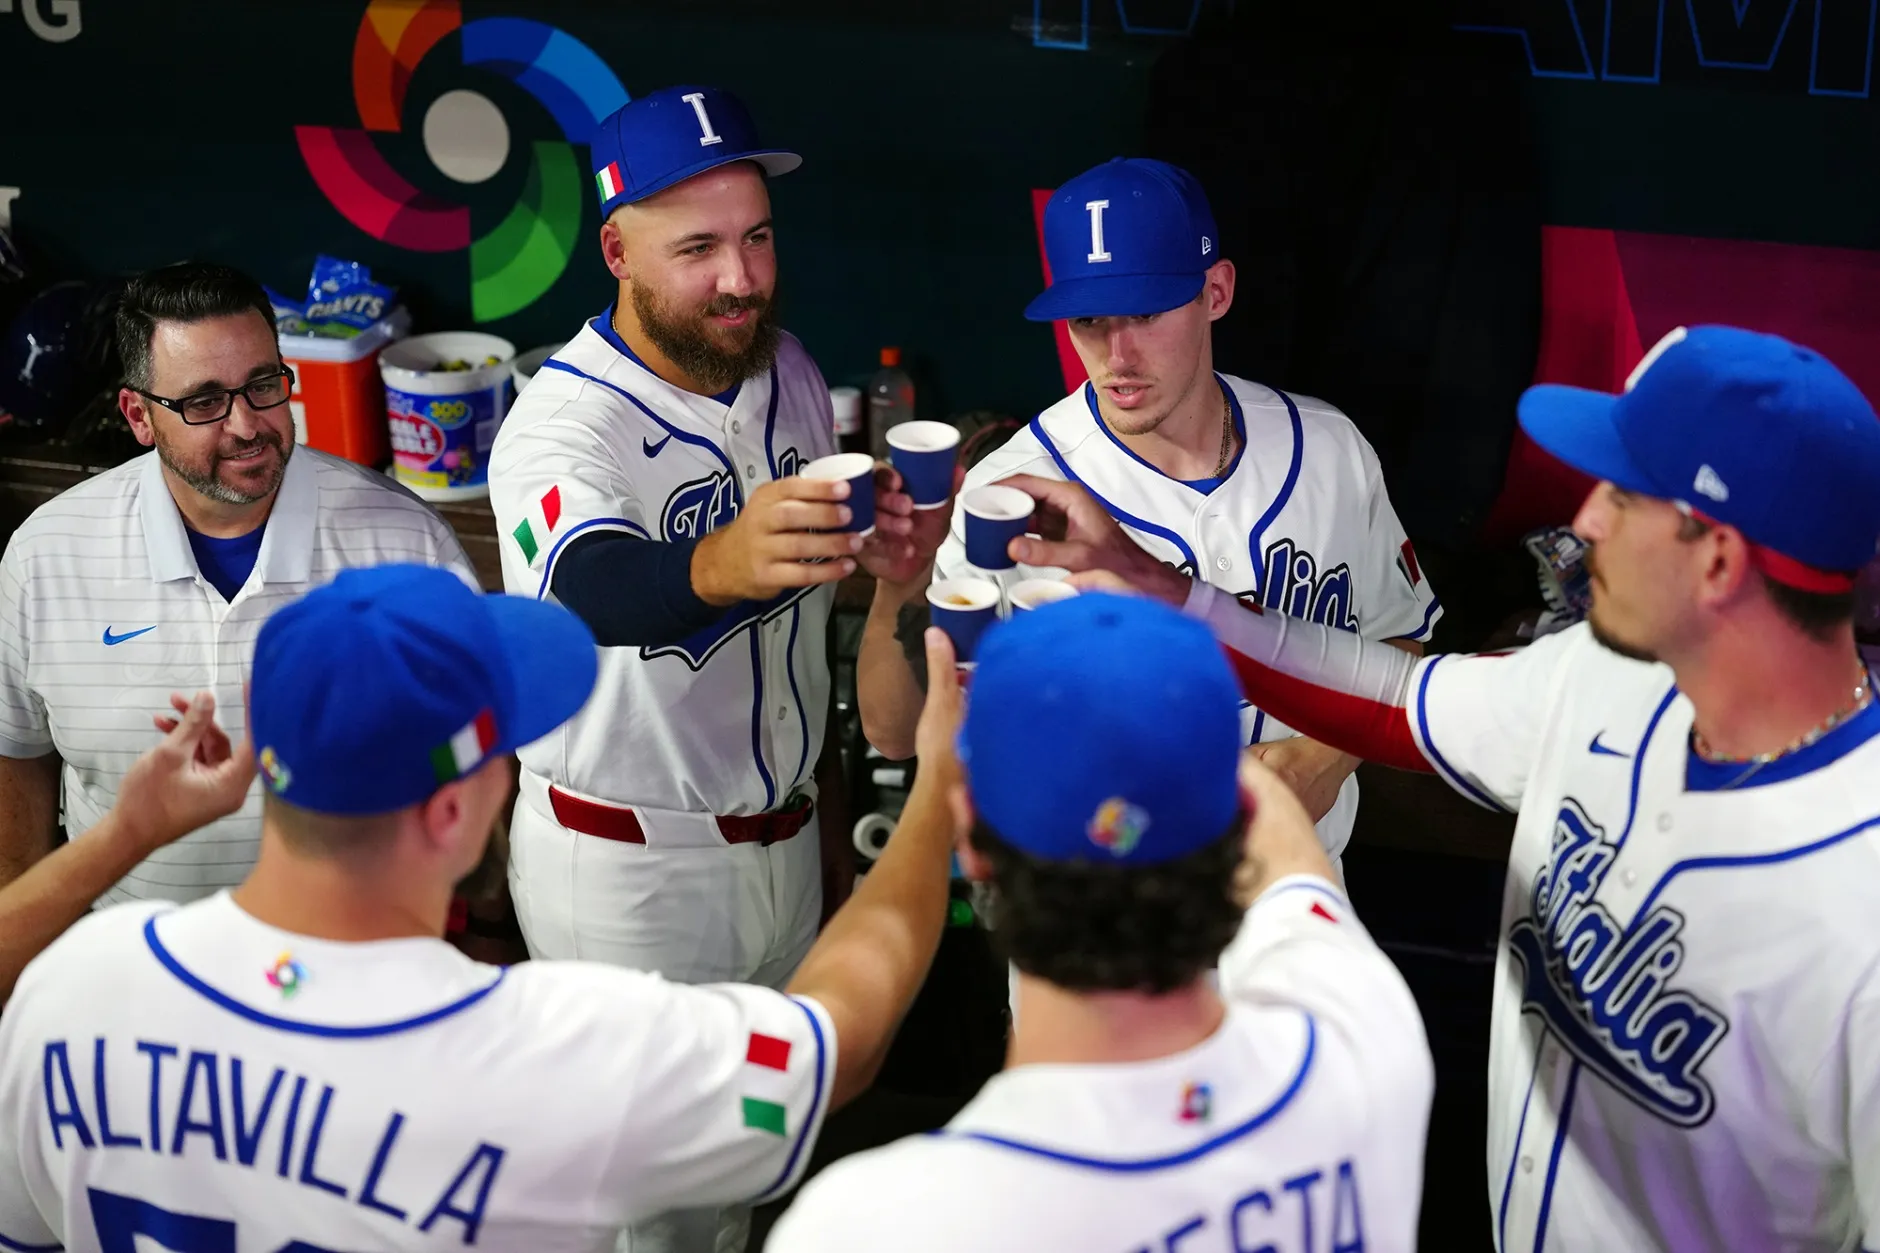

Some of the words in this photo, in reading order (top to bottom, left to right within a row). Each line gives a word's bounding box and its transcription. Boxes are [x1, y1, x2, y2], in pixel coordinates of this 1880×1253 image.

[682, 92, 723, 147] I
[1085, 199, 1112, 264] I
[1526, 796, 1729, 1090] Italia
[43, 1037, 507, 1246] ALTAVILLA
